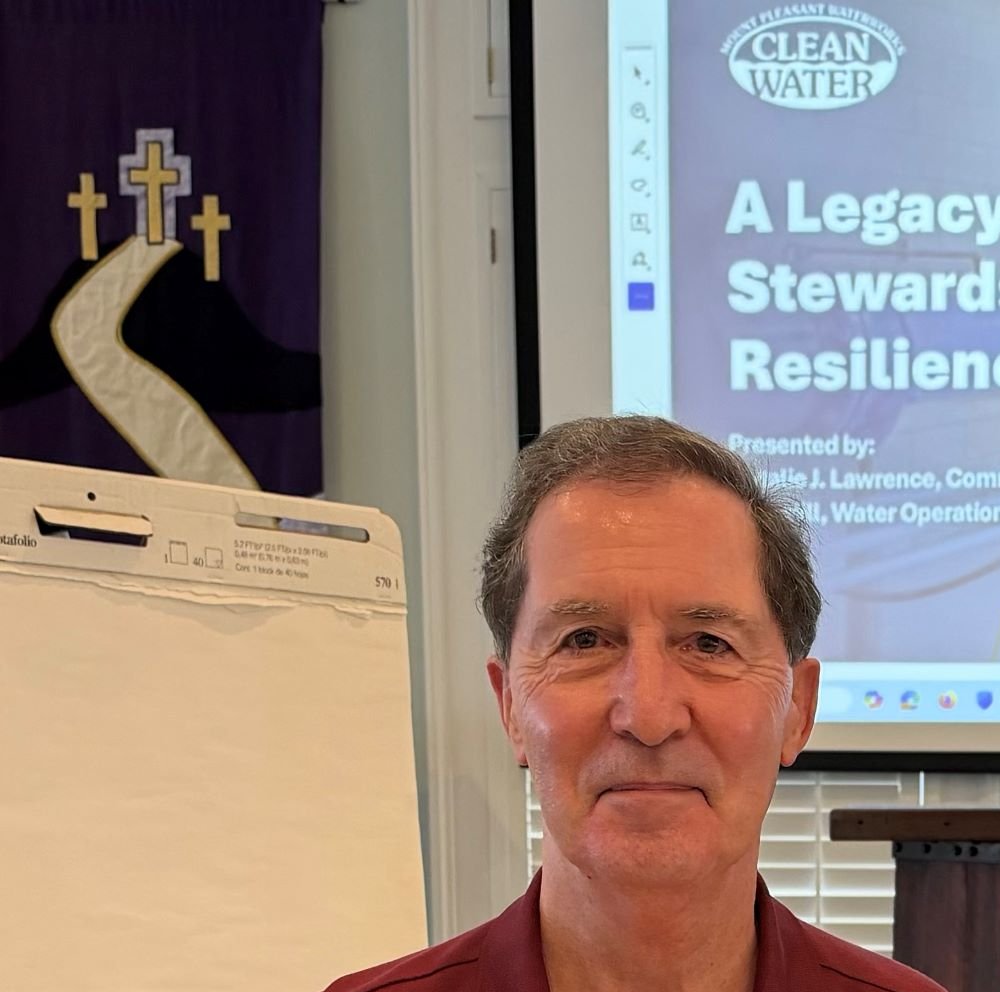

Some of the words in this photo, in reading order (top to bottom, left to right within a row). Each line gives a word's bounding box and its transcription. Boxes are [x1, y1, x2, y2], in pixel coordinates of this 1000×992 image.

[720, 15, 759, 54] MOUNT
[758, 3, 825, 24] PLEASANT
[752, 31, 870, 61] CLEAN
[749, 69, 874, 98] WATER
[726, 180, 773, 234] A
[728, 433, 840, 455] Presented
[843, 434, 876, 460] by:
[830, 468, 942, 492] Lawrence,
[831, 502, 898, 523] Water
[375, 575, 391, 590] 570
